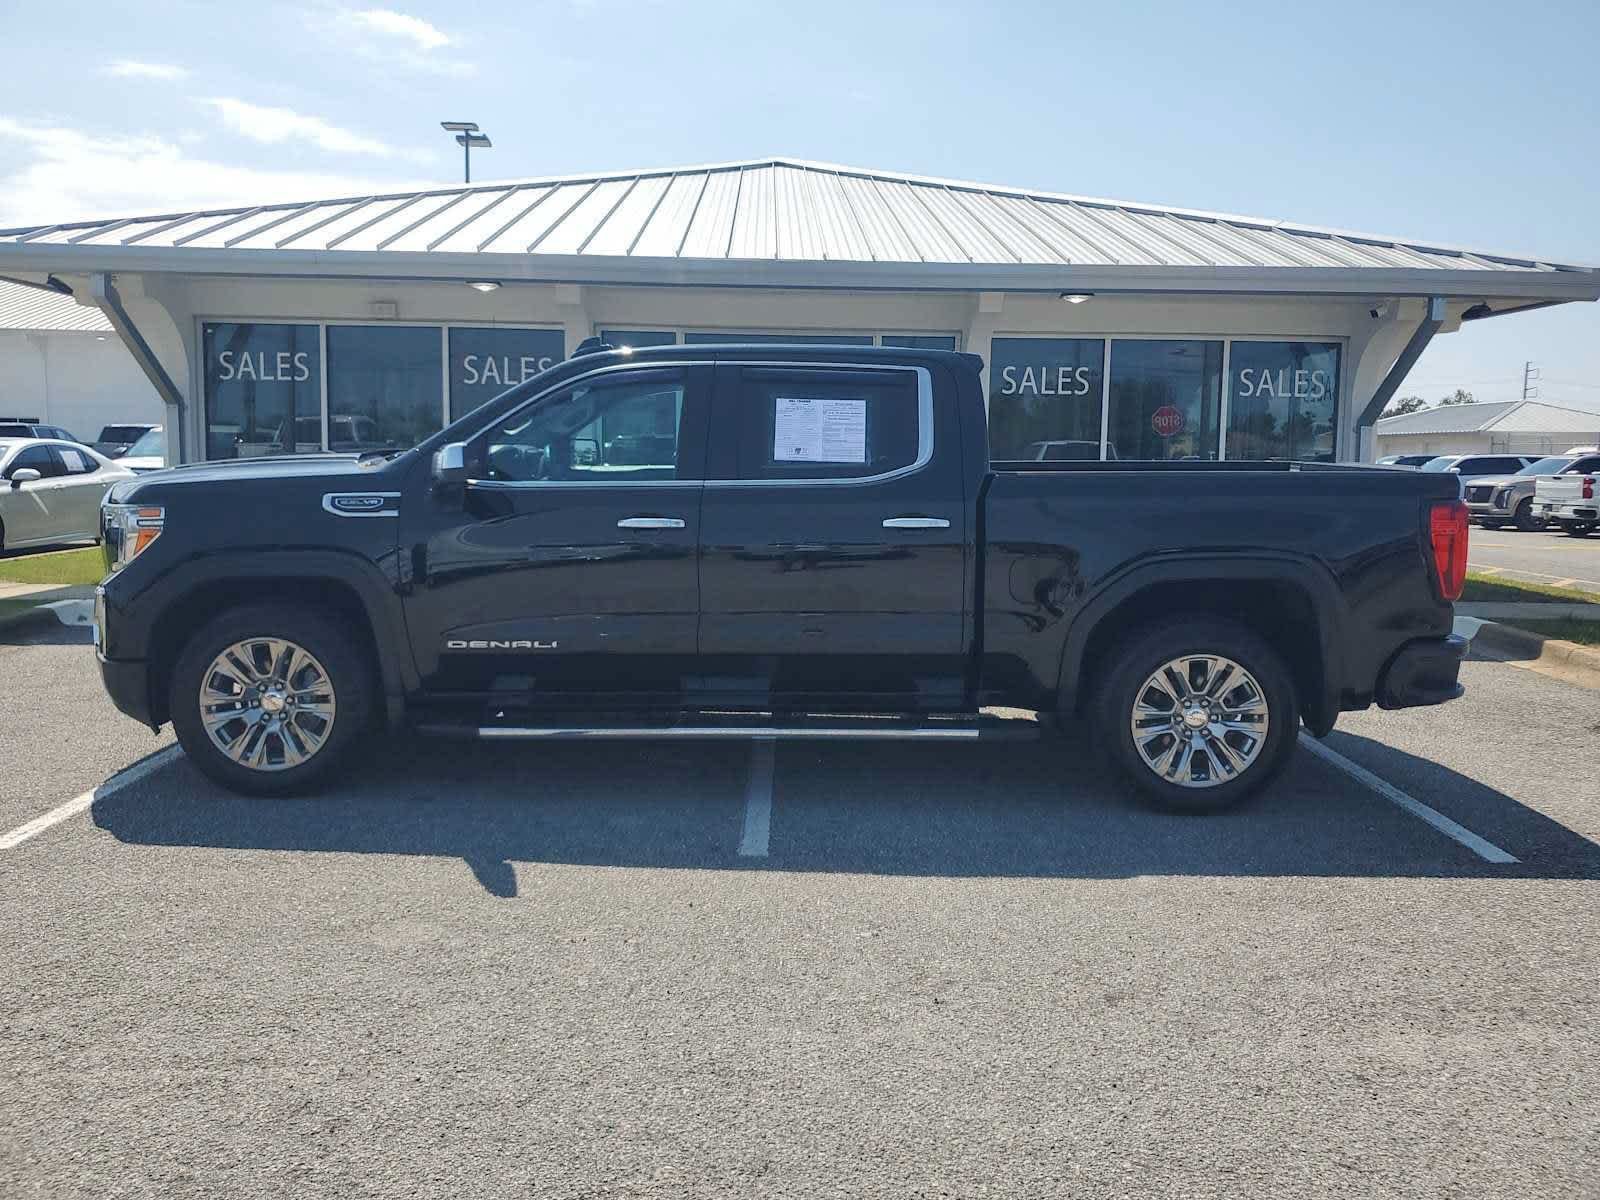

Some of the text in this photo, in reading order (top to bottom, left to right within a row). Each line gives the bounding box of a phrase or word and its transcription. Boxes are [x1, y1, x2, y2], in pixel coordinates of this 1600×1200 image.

[219, 351, 310, 381] SALES
[1001, 366, 1090, 395] SALES
[1239, 368, 1325, 398] SALES
[447, 640, 557, 649] DENALI
